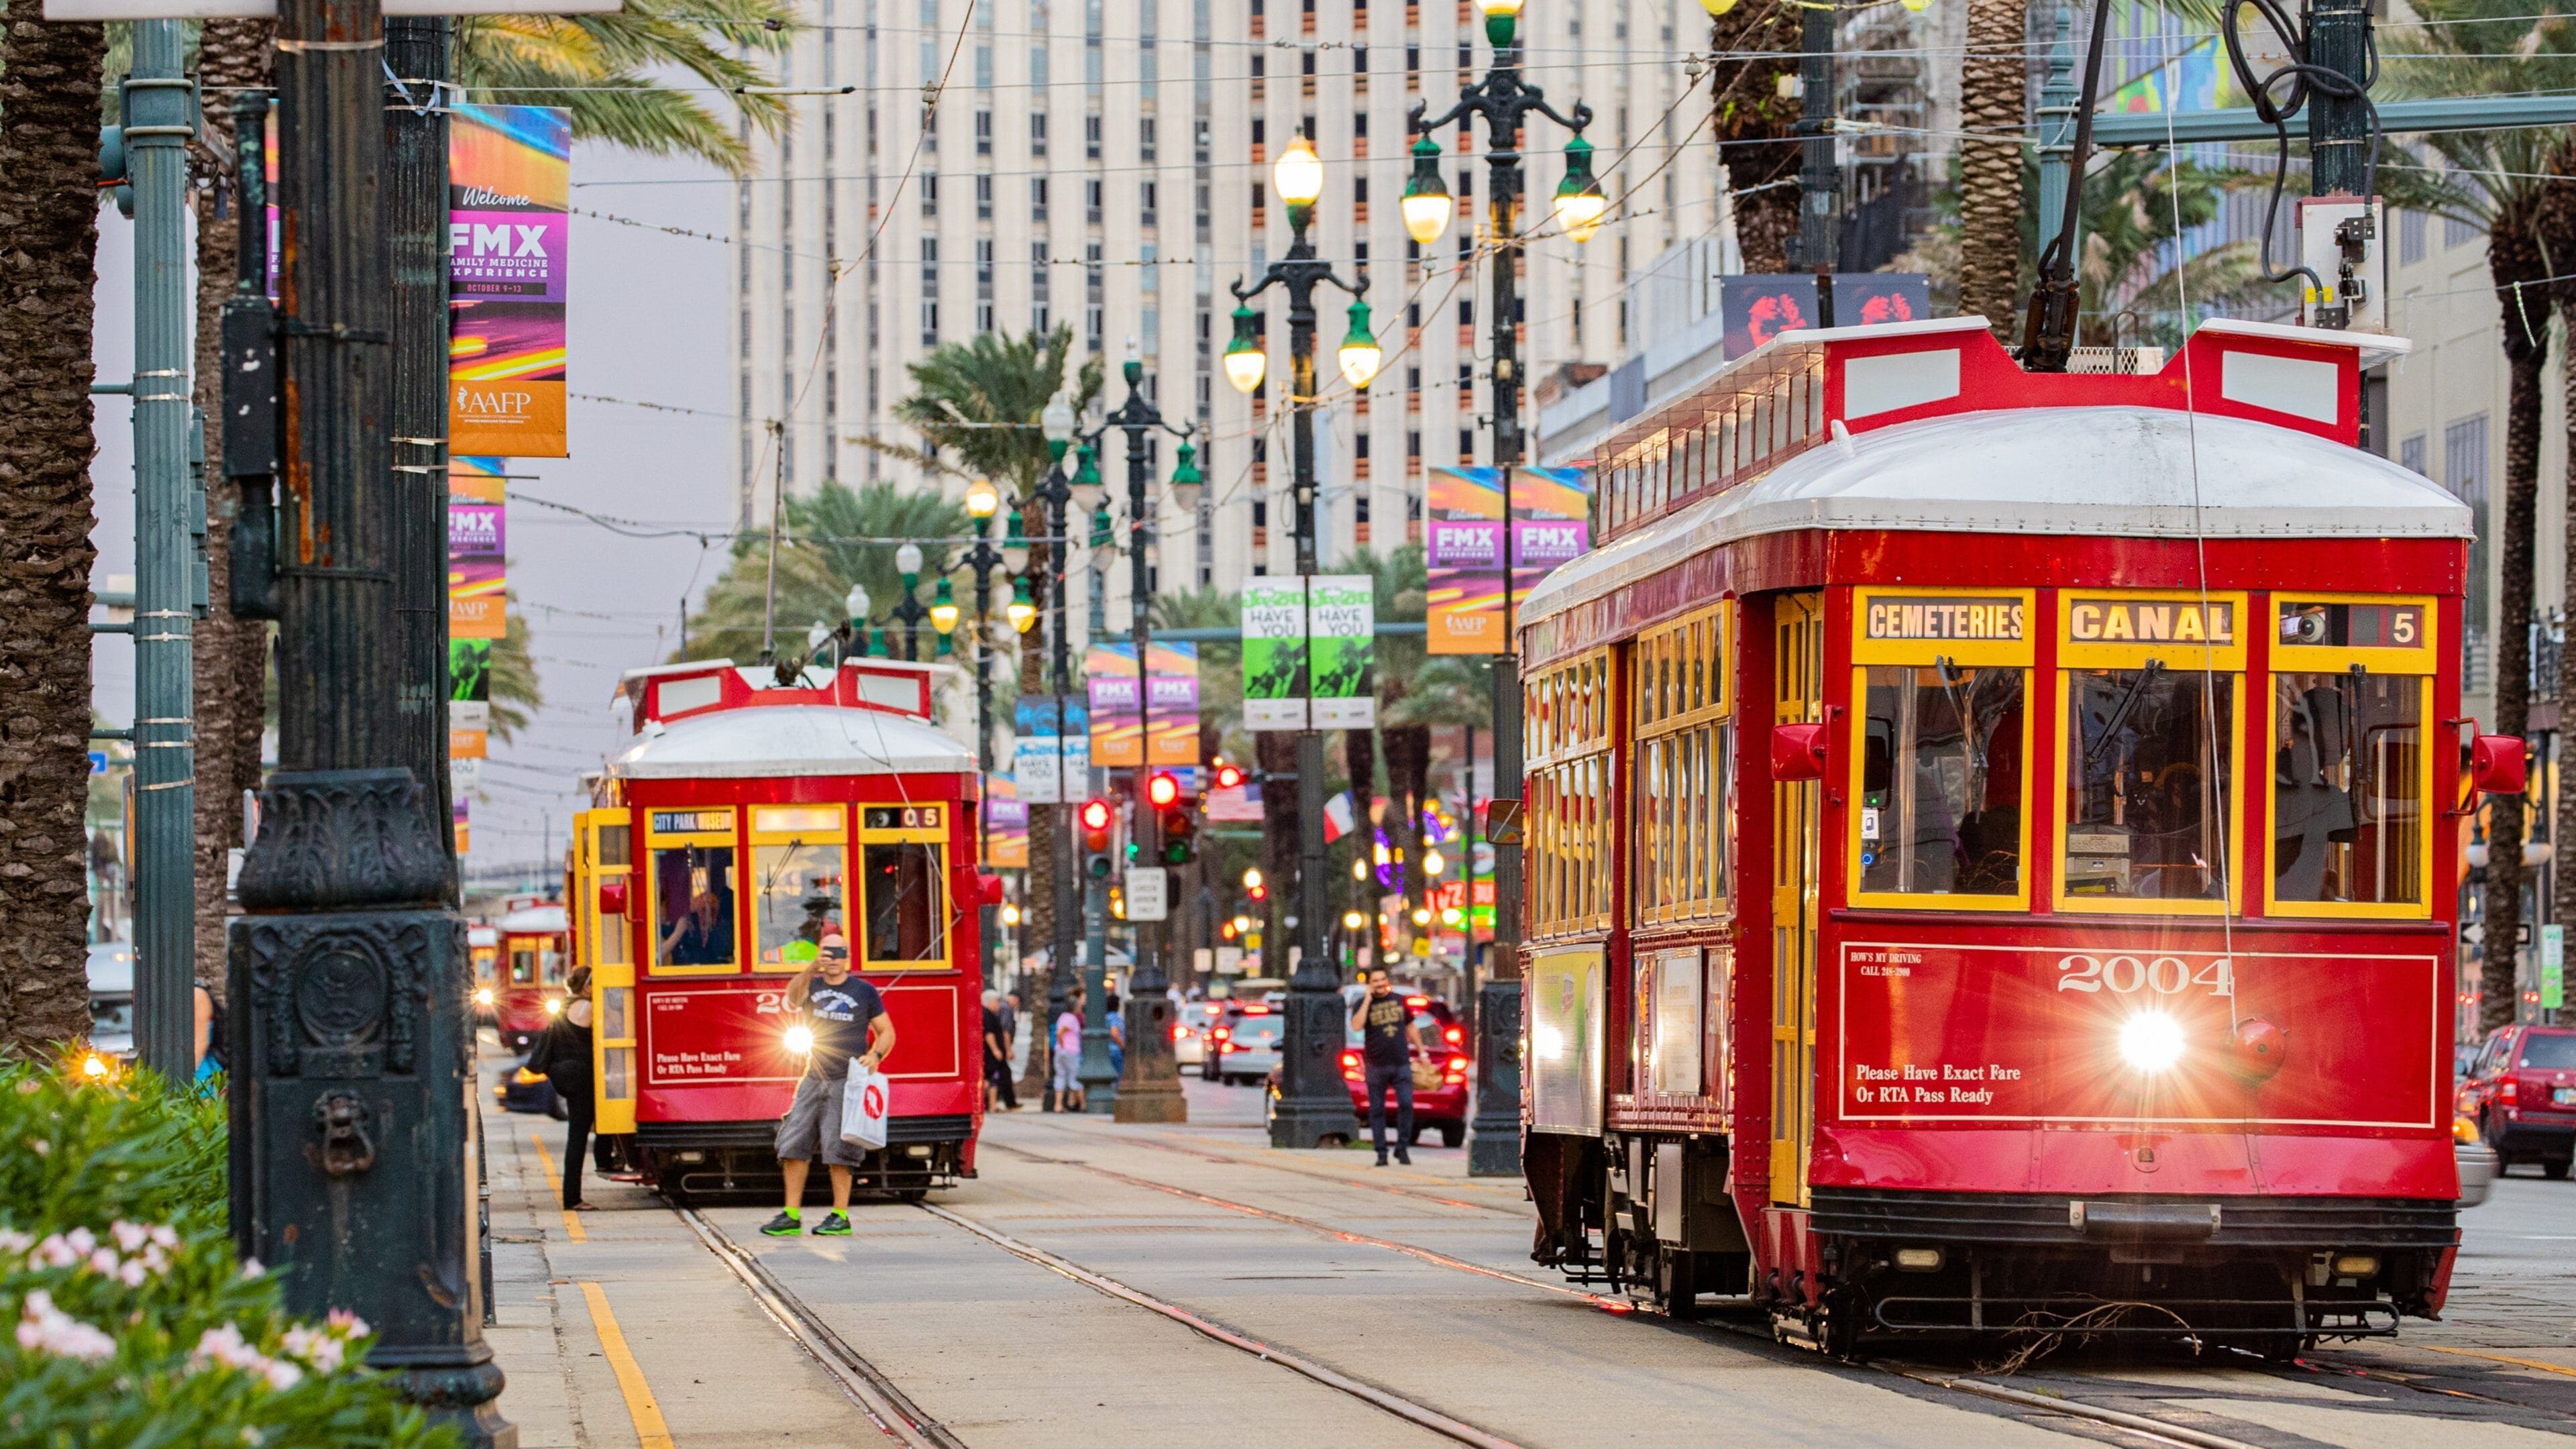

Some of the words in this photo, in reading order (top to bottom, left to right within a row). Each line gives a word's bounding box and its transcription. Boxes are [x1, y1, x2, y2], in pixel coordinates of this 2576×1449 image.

[462, 185, 530, 206] Welcome
[449, 223, 548, 258] FMX
[450, 258, 484, 266] AMILY
[490, 259, 548, 268] MEDICINE
[449, 268, 548, 277] XPERIENCE
[468, 392, 531, 413] AAFP
[1437, 528, 1494, 546] FMX
[1521, 527, 1578, 546] FMX
[1250, 609, 1294, 622] HAVE
[1318, 609, 1361, 621] HAVE
[1870, 604, 2023, 639] CEMETERIES
[1260, 625, 1296, 636] YOU
[1328, 624, 1364, 635] YOU
[2072, 606, 2233, 641] CANAL
[2394, 613, 2415, 643] 5
[654, 814, 671, 830] CITY
[1850, 952, 1873, 962] HOW'S
[1875, 953, 1886, 963] MY
[1889, 953, 1921, 963] DRIVING
[1861, 965, 1880, 976] CALL
[2058, 955, 2233, 996] 2004
[680, 1053, 699, 1062] Have
[700, 1052, 722, 1061] Exact
[724, 1051, 741, 1061] Fare
[657, 1065, 667, 1074] Or
[668, 1064, 685, 1074] RTA
[686, 1064, 703, 1073] Pass
[704, 1063, 727, 1074] Ready
[1856, 1065, 1898, 1080] Please
[1904, 1065, 1938, 1080] Have
[1943, 1065, 1984, 1080] Exact
[1990, 1065, 2021, 1080] Fare
[1856, 1087, 1874, 1102] Or
[1880, 1087, 1910, 1102] RTA
[1915, 1087, 1945, 1102] Pass
[1950, 1087, 1994, 1105] Ready
